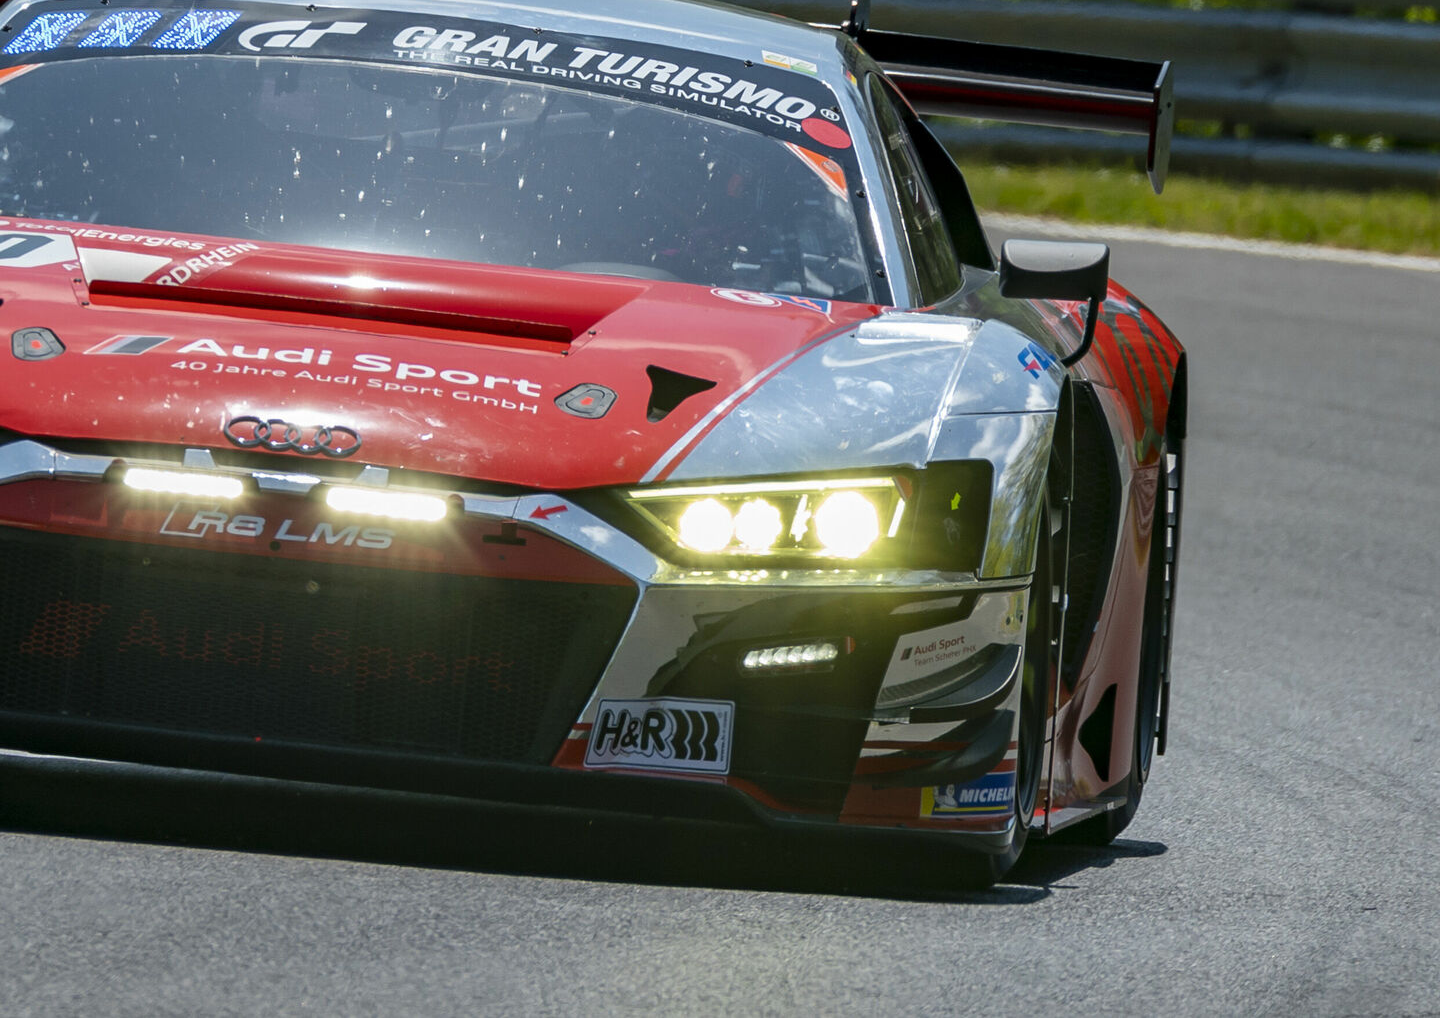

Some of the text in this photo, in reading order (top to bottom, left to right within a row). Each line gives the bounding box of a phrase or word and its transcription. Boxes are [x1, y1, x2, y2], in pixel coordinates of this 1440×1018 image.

[392, 25, 559, 63] GRAN
[568, 46, 817, 120] TURISMO
[393, 49, 803, 133] THE REAL DRIVING SIMULATOR
[16, 222, 206, 251] TotalEnergies
[170, 360, 539, 415] 40 Jahre Audi Sport GmbH
[176, 338, 542, 398] Audi Sport
[187, 510, 397, 549] R8 LMS
[117, 608, 518, 694] Audi Sport
[913, 635, 965, 656] Audi Sport
[595, 708, 672, 757] H&R
